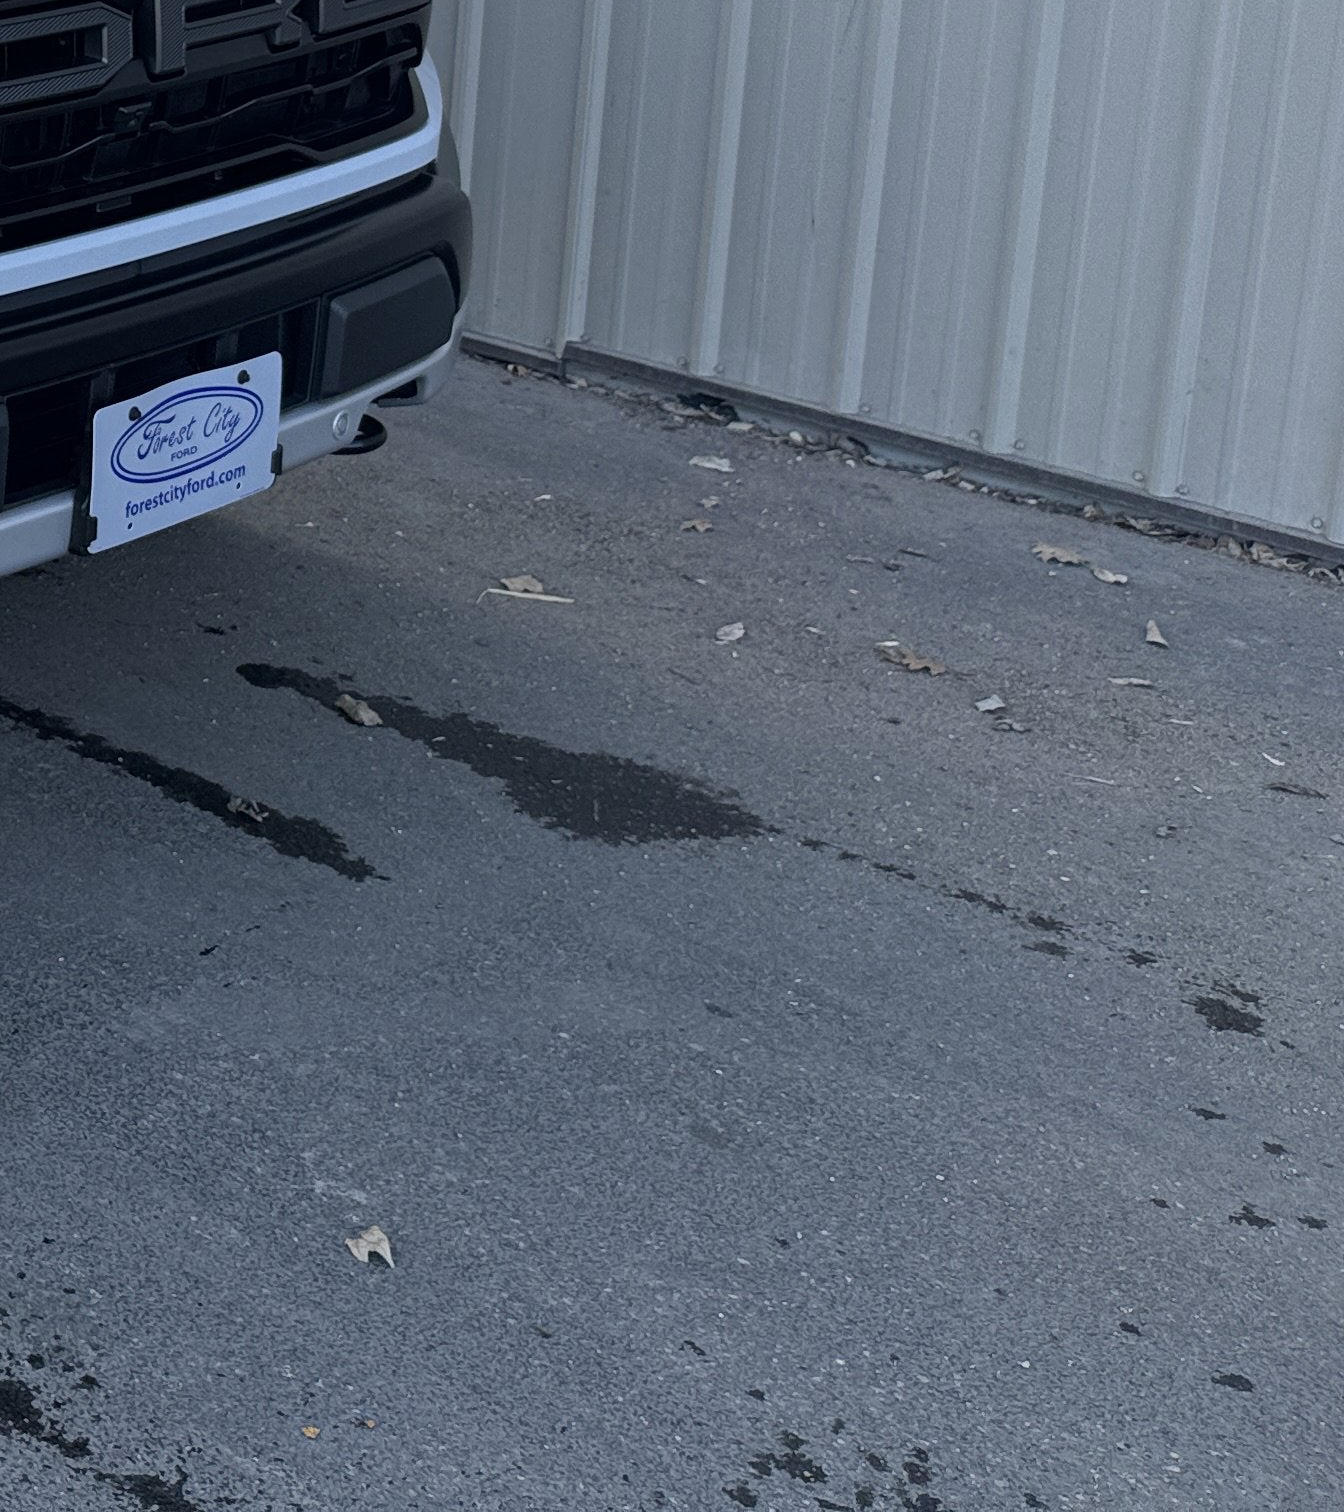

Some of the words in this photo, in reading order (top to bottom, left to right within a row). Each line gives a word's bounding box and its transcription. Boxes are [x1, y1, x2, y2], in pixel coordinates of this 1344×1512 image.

[137, 414, 197, 461] Forest
[203, 402, 241, 443] City
[170, 445, 198, 462] FORD
[125, 464, 246, 518] forestcityford.com
